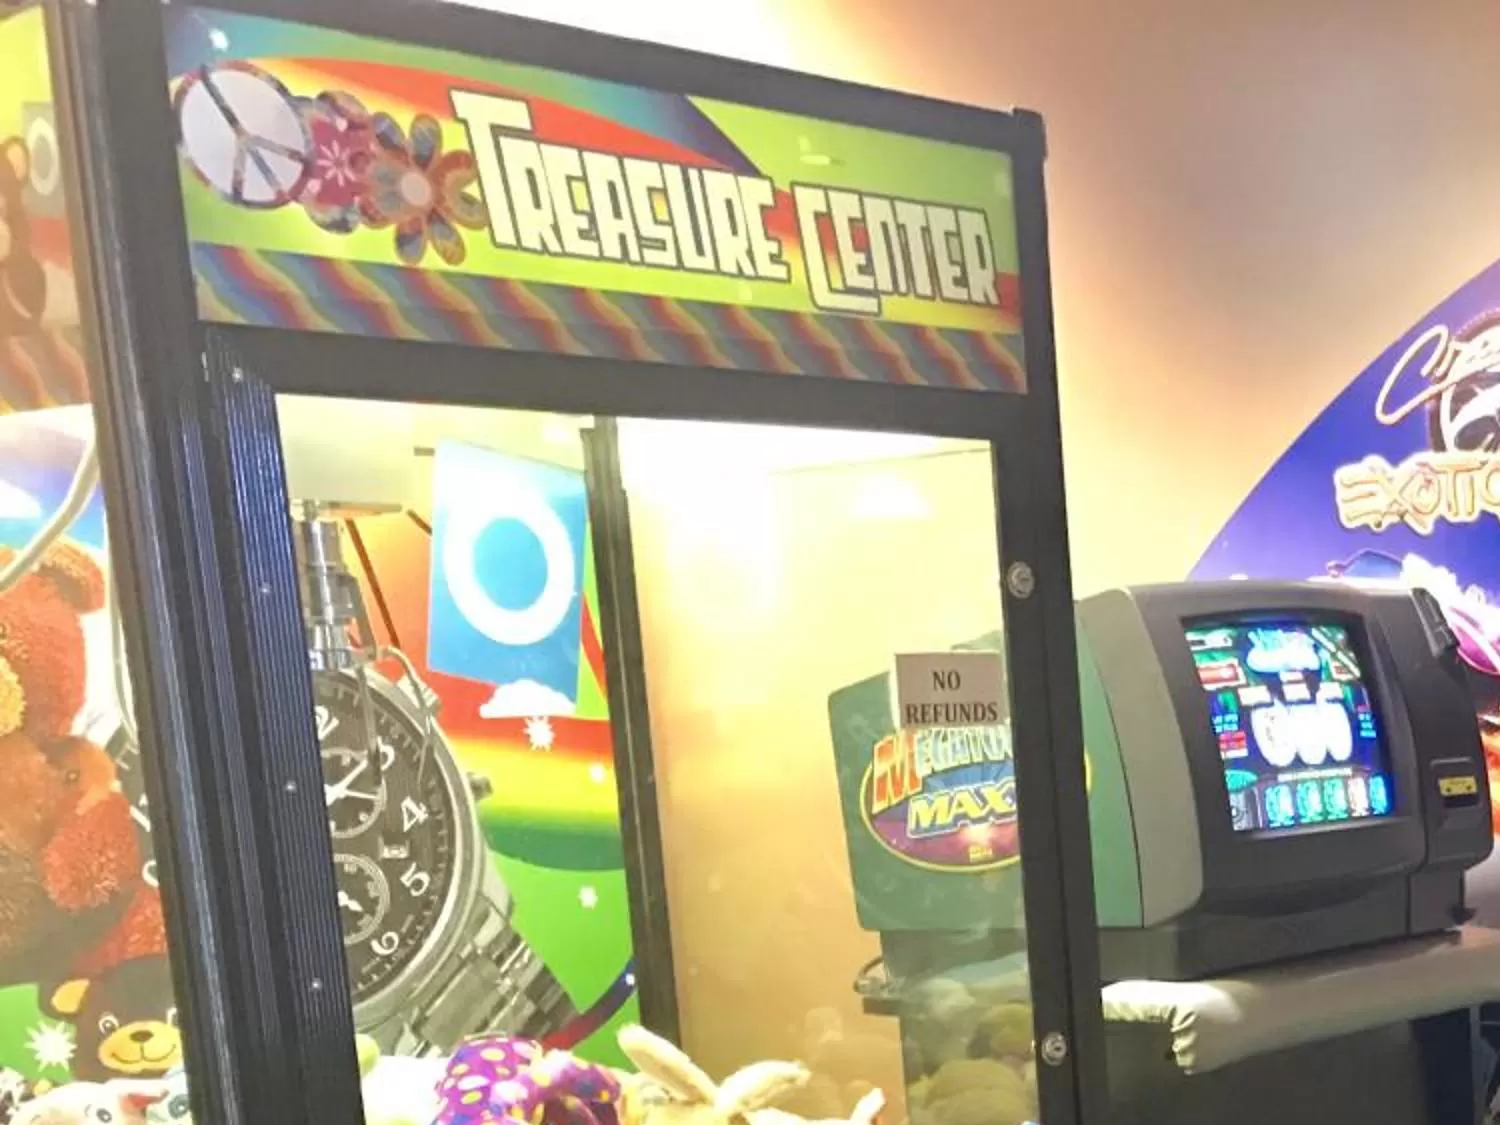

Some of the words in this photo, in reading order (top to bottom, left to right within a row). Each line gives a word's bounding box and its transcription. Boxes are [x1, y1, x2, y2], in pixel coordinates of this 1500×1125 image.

[449, 89, 791, 282] TREASURE
[791, 182, 1000, 316] CENTER
[932, 671, 960, 690] NO
[906, 702, 998, 724] REFUNDS
